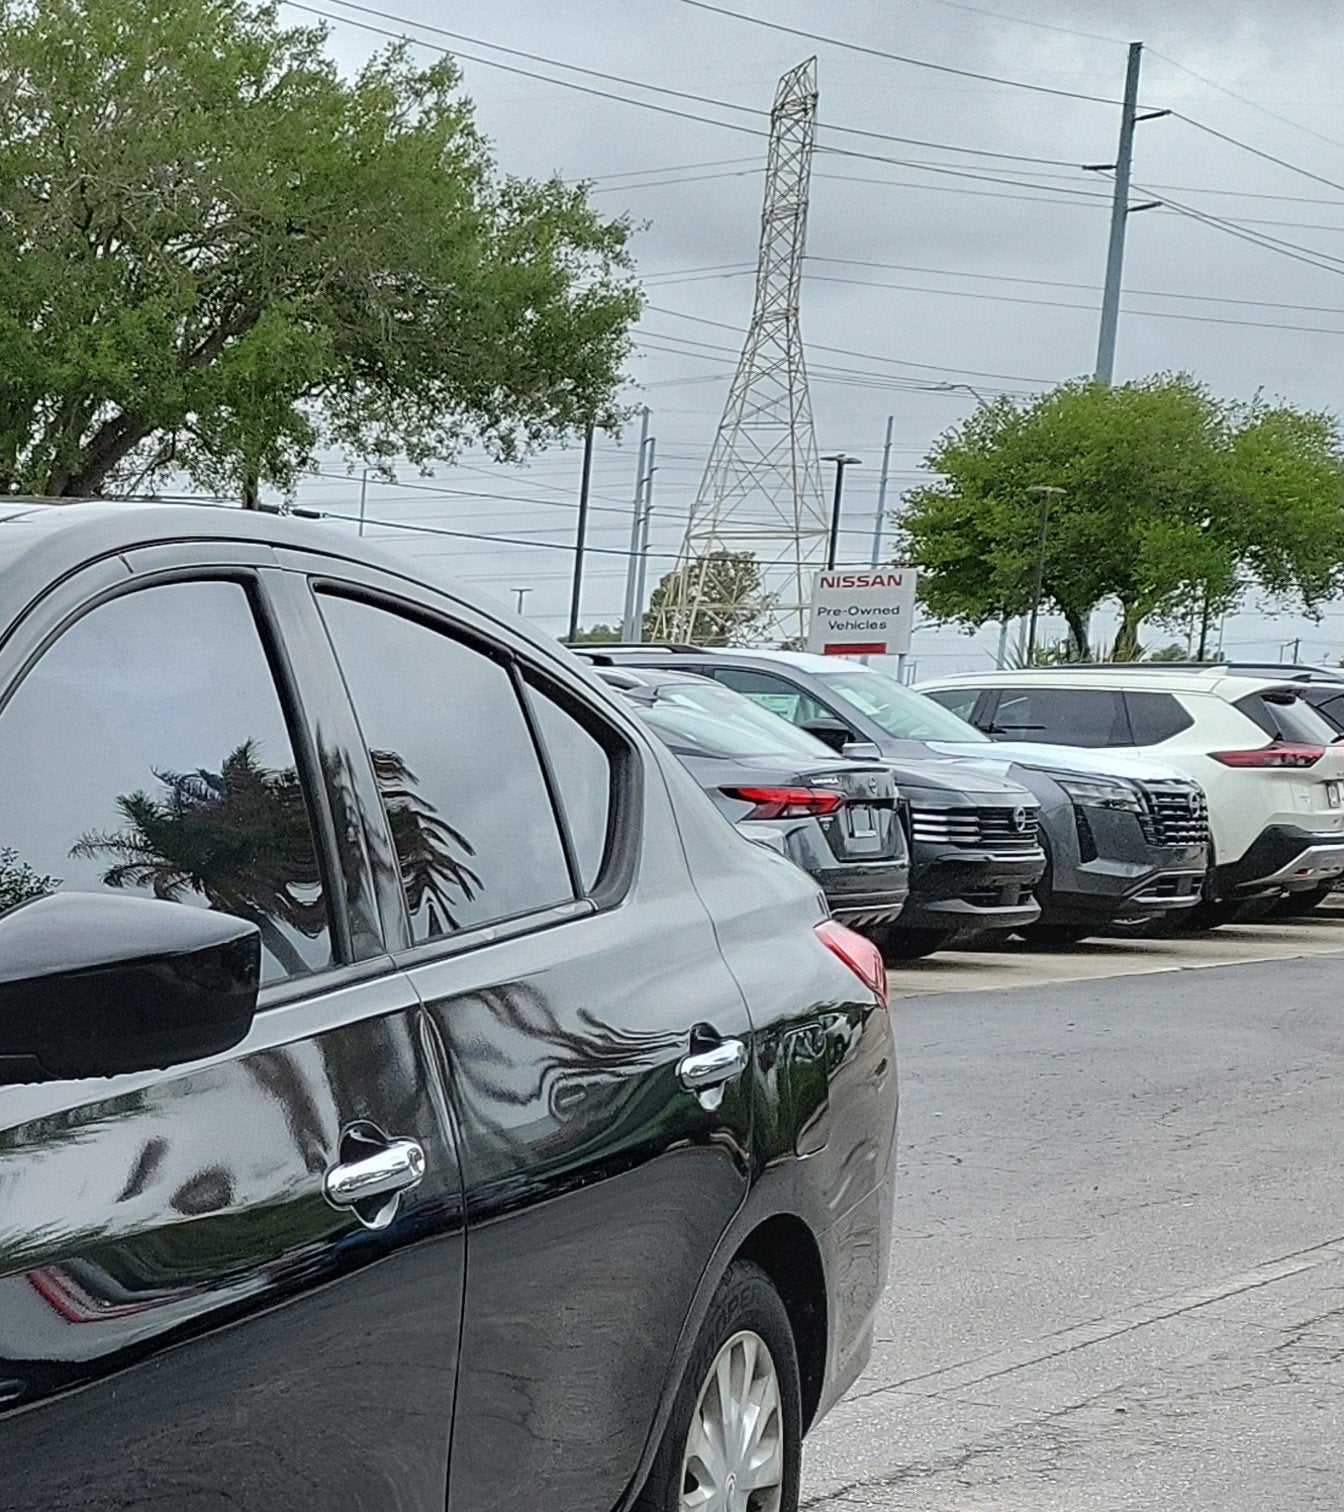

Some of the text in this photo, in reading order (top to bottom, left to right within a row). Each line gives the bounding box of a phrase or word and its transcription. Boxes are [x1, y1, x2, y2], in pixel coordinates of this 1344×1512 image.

[820, 574, 902, 588] NISSAN
[817, 605, 900, 616] Pre-Owned
[828, 620, 887, 630] Vehicles
